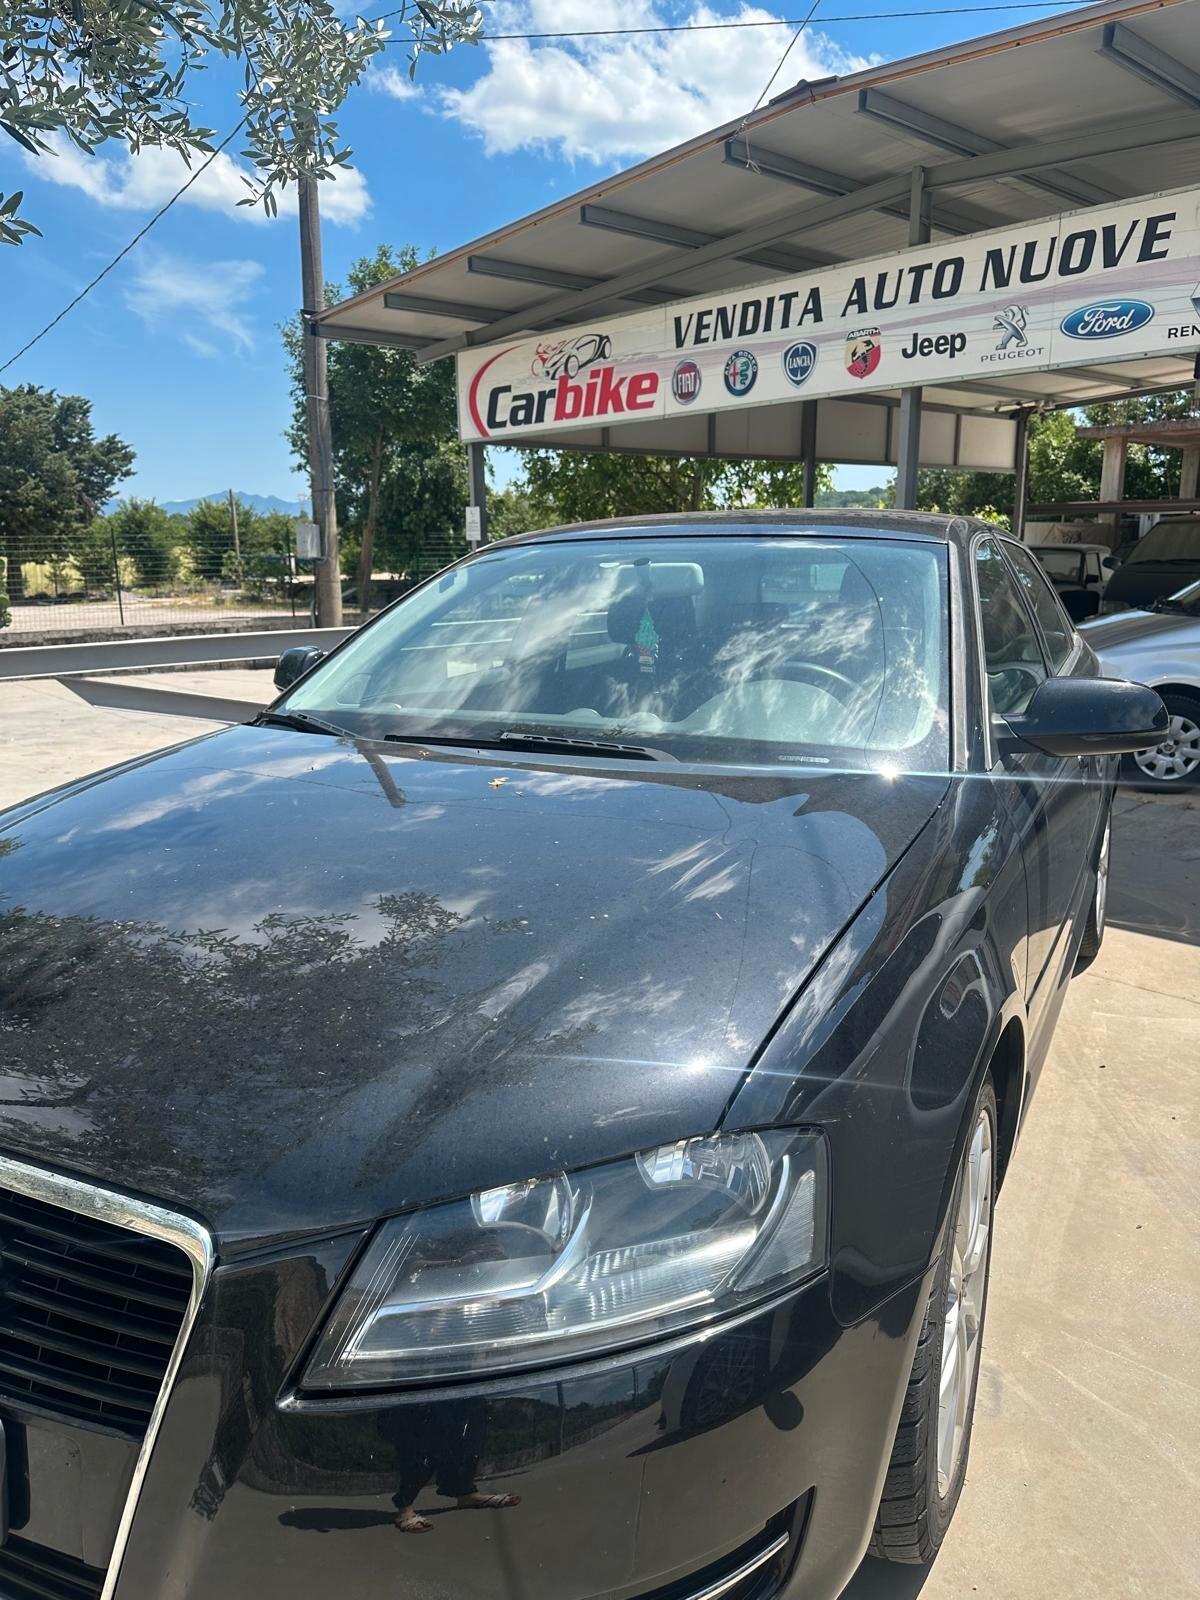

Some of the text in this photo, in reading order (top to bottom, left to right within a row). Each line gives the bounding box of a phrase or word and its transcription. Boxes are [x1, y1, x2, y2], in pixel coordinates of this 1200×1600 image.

[674, 211, 1177, 349] VENDITA AUTO NUOVE
[1077, 306, 1135, 334] Ford
[848, 328, 880, 339] ABARTH
[901, 331, 967, 359] Jeep
[788, 354, 811, 369] LANCIA
[980, 347, 1045, 363] PEUGEOT
[678, 371, 696, 394] FIAT
[486, 366, 659, 430] Carbike
